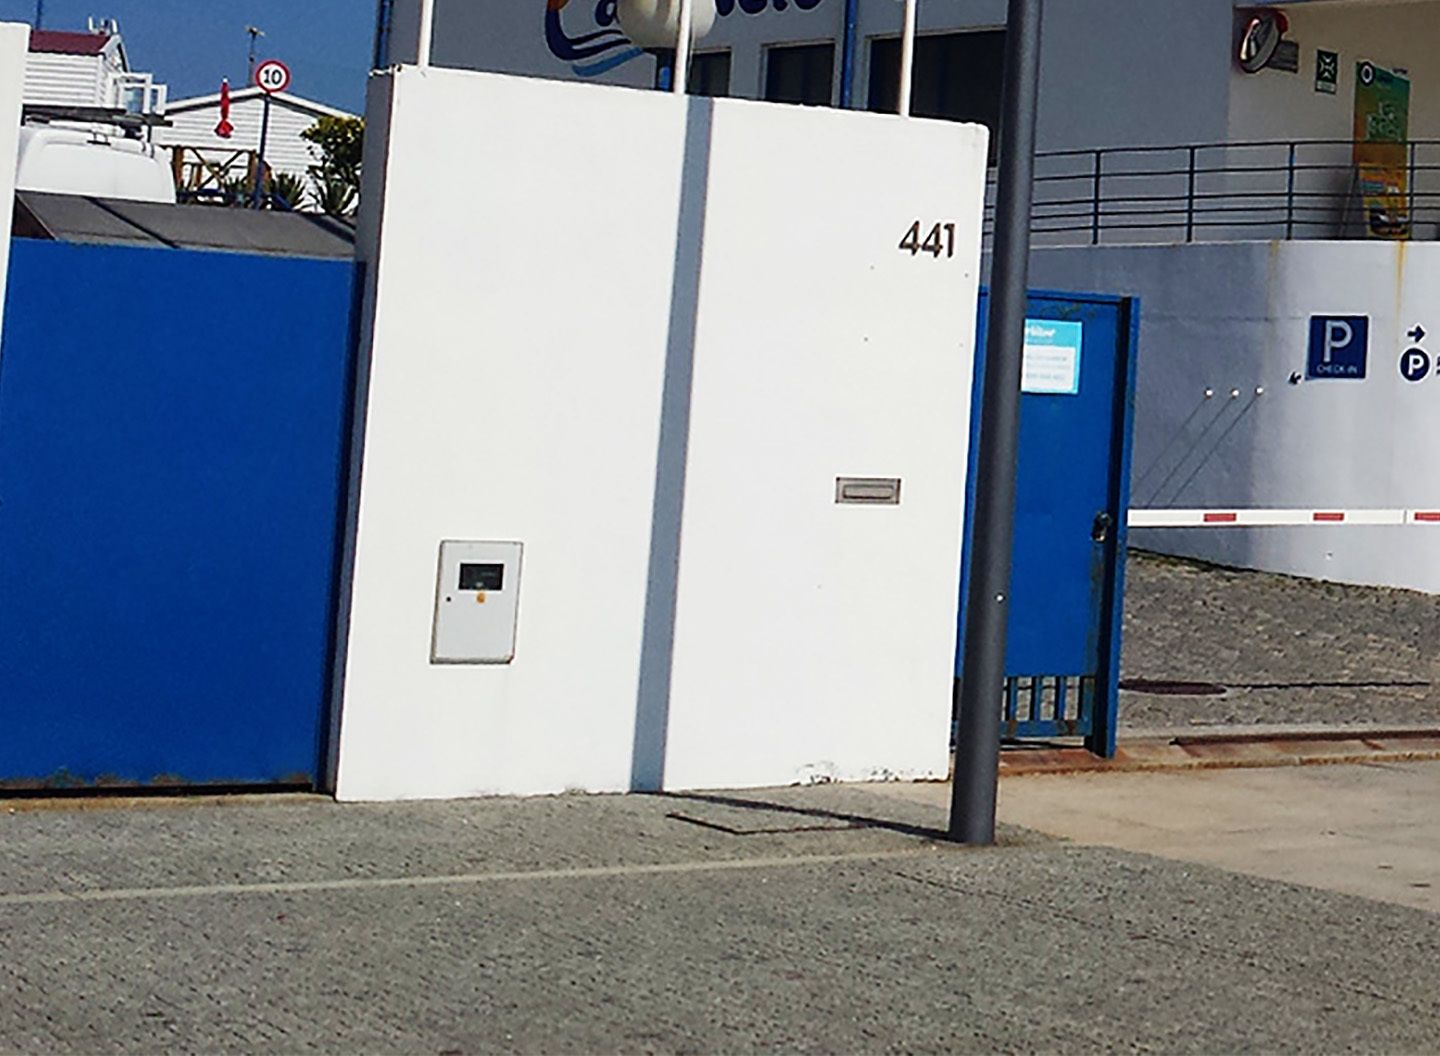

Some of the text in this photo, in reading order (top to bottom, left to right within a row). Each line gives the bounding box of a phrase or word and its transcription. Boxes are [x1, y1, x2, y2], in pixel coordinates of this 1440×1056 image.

[263, 68, 283, 85] 10
[898, 219, 956, 259] 441
[1322, 319, 1353, 363] P
[1408, 354, 1425, 376] P
